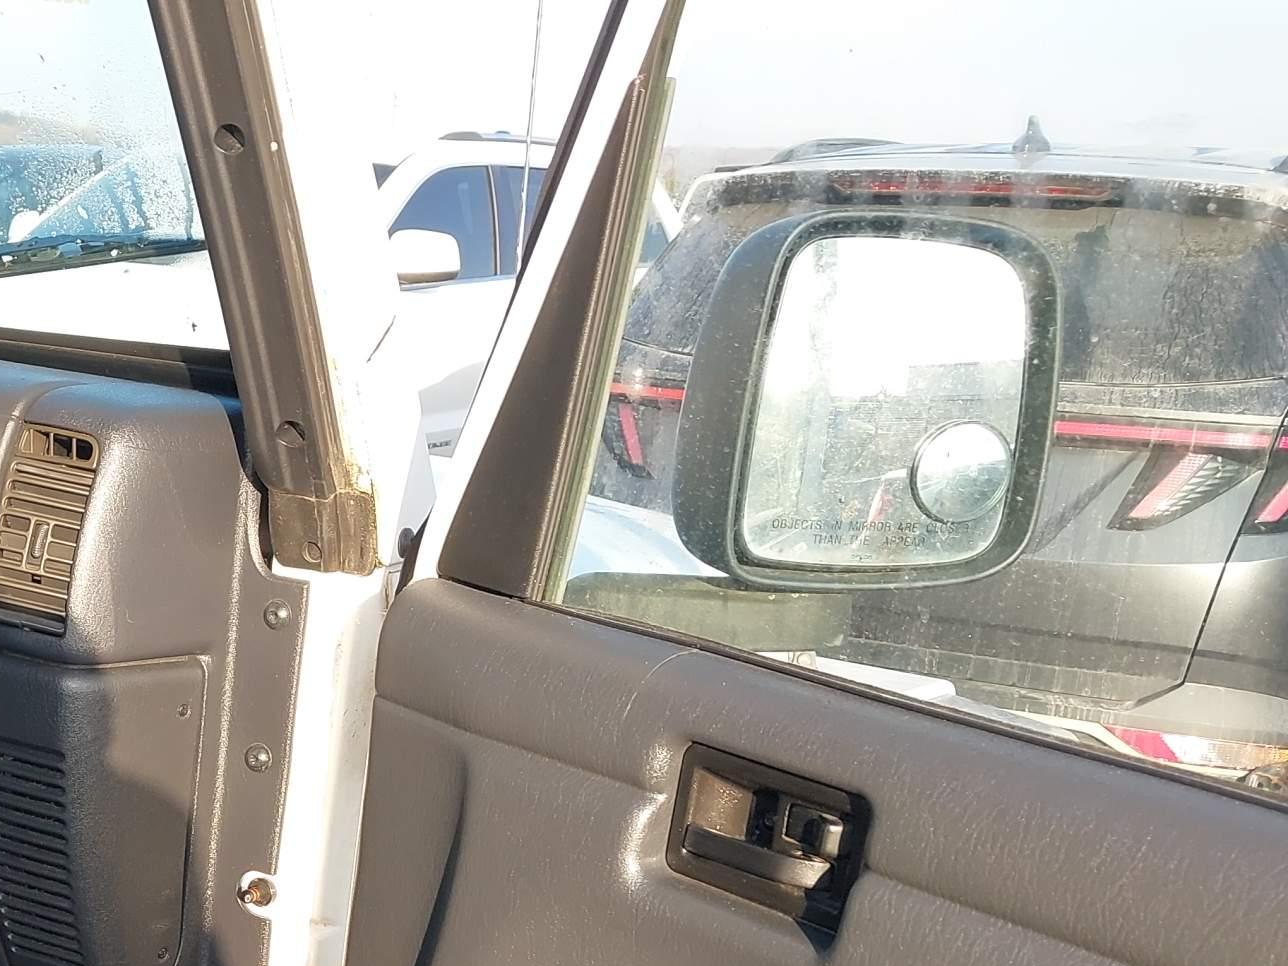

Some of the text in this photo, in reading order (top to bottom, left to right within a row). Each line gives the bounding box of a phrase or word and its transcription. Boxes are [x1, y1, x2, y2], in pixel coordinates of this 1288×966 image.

[771, 518, 971, 534] OBJECTS IN MIRROR ARE CLOSR
[812, 534, 843, 546] THAN
